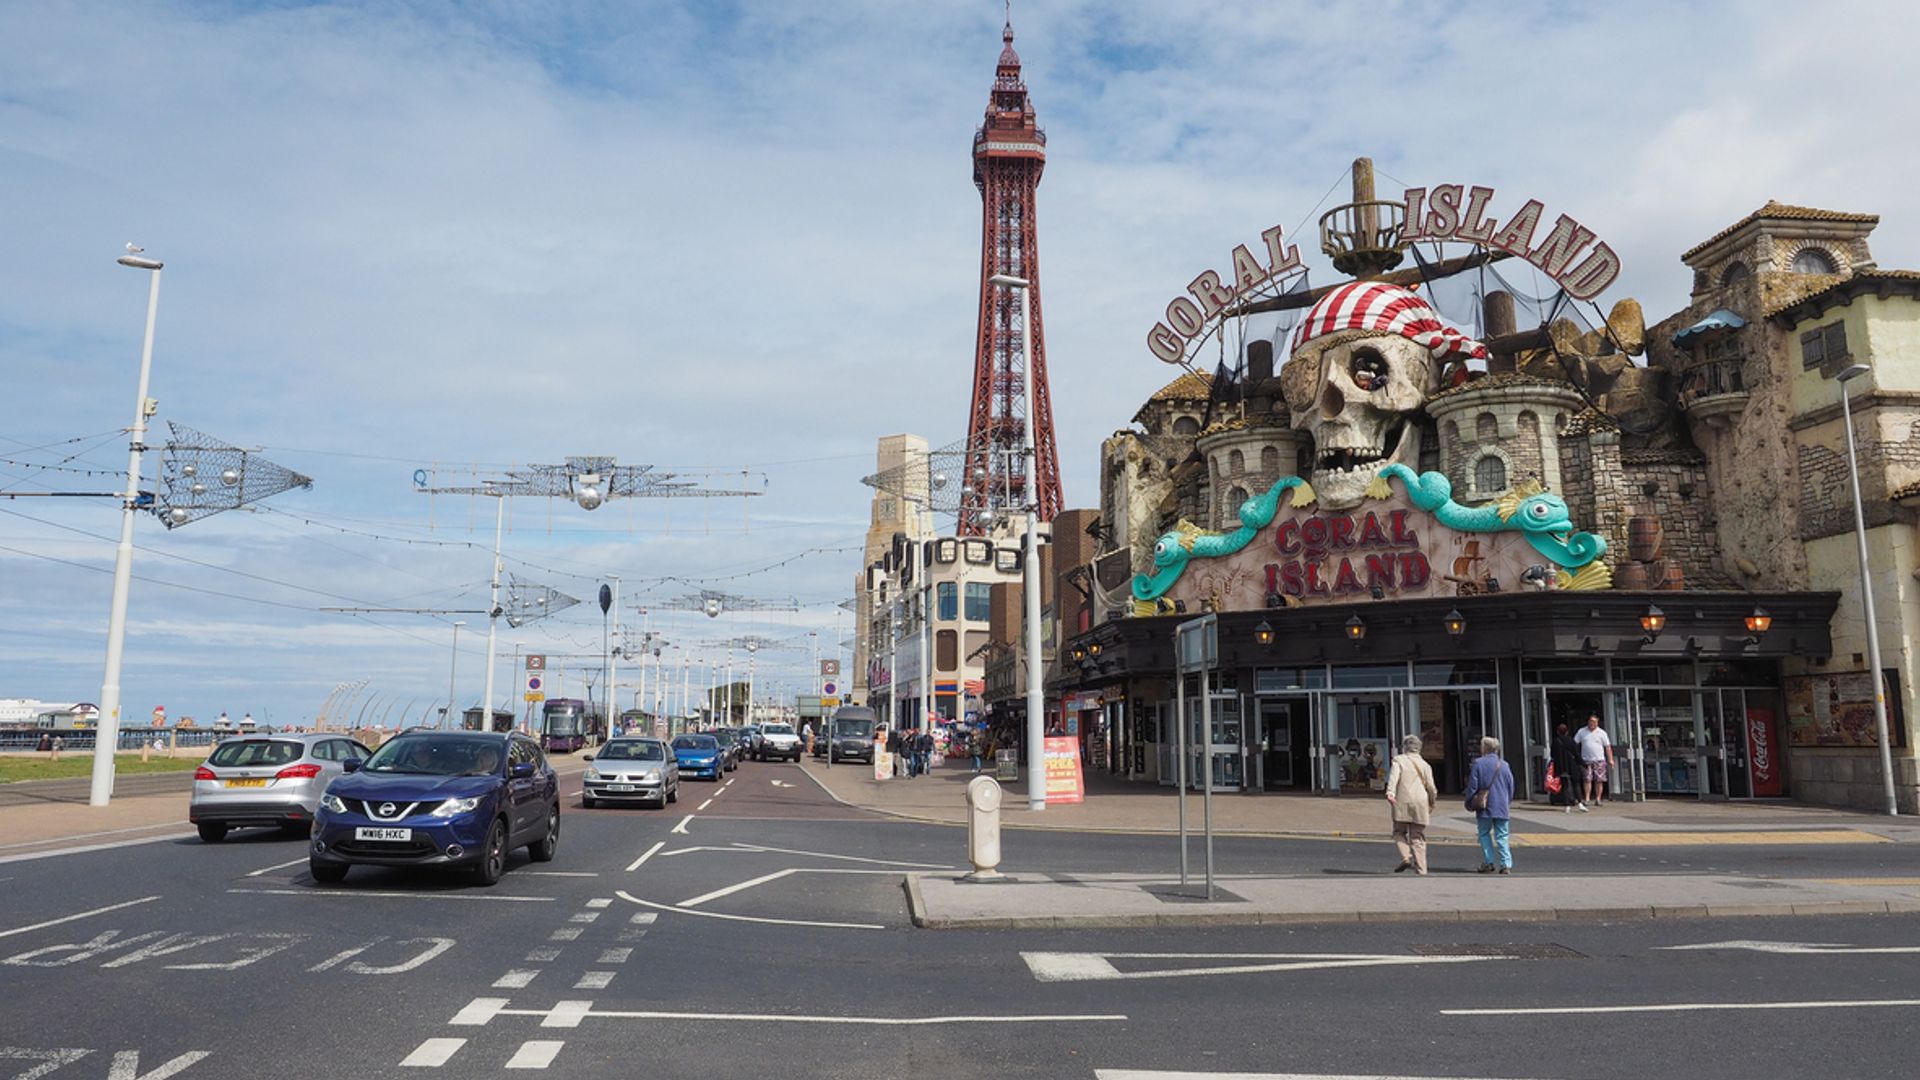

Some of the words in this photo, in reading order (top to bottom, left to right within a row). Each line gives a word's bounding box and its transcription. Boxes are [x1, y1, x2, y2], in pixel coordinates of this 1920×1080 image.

[1147, 225, 1302, 364] CORAL
[1401, 184, 1621, 300] ISLAND
[1275, 510, 1420, 554] CORAL
[1265, 551, 1431, 599] ISLAND
[1750, 719, 1770, 770] Coca-Cola
[385, 829, 405, 839] HXC
